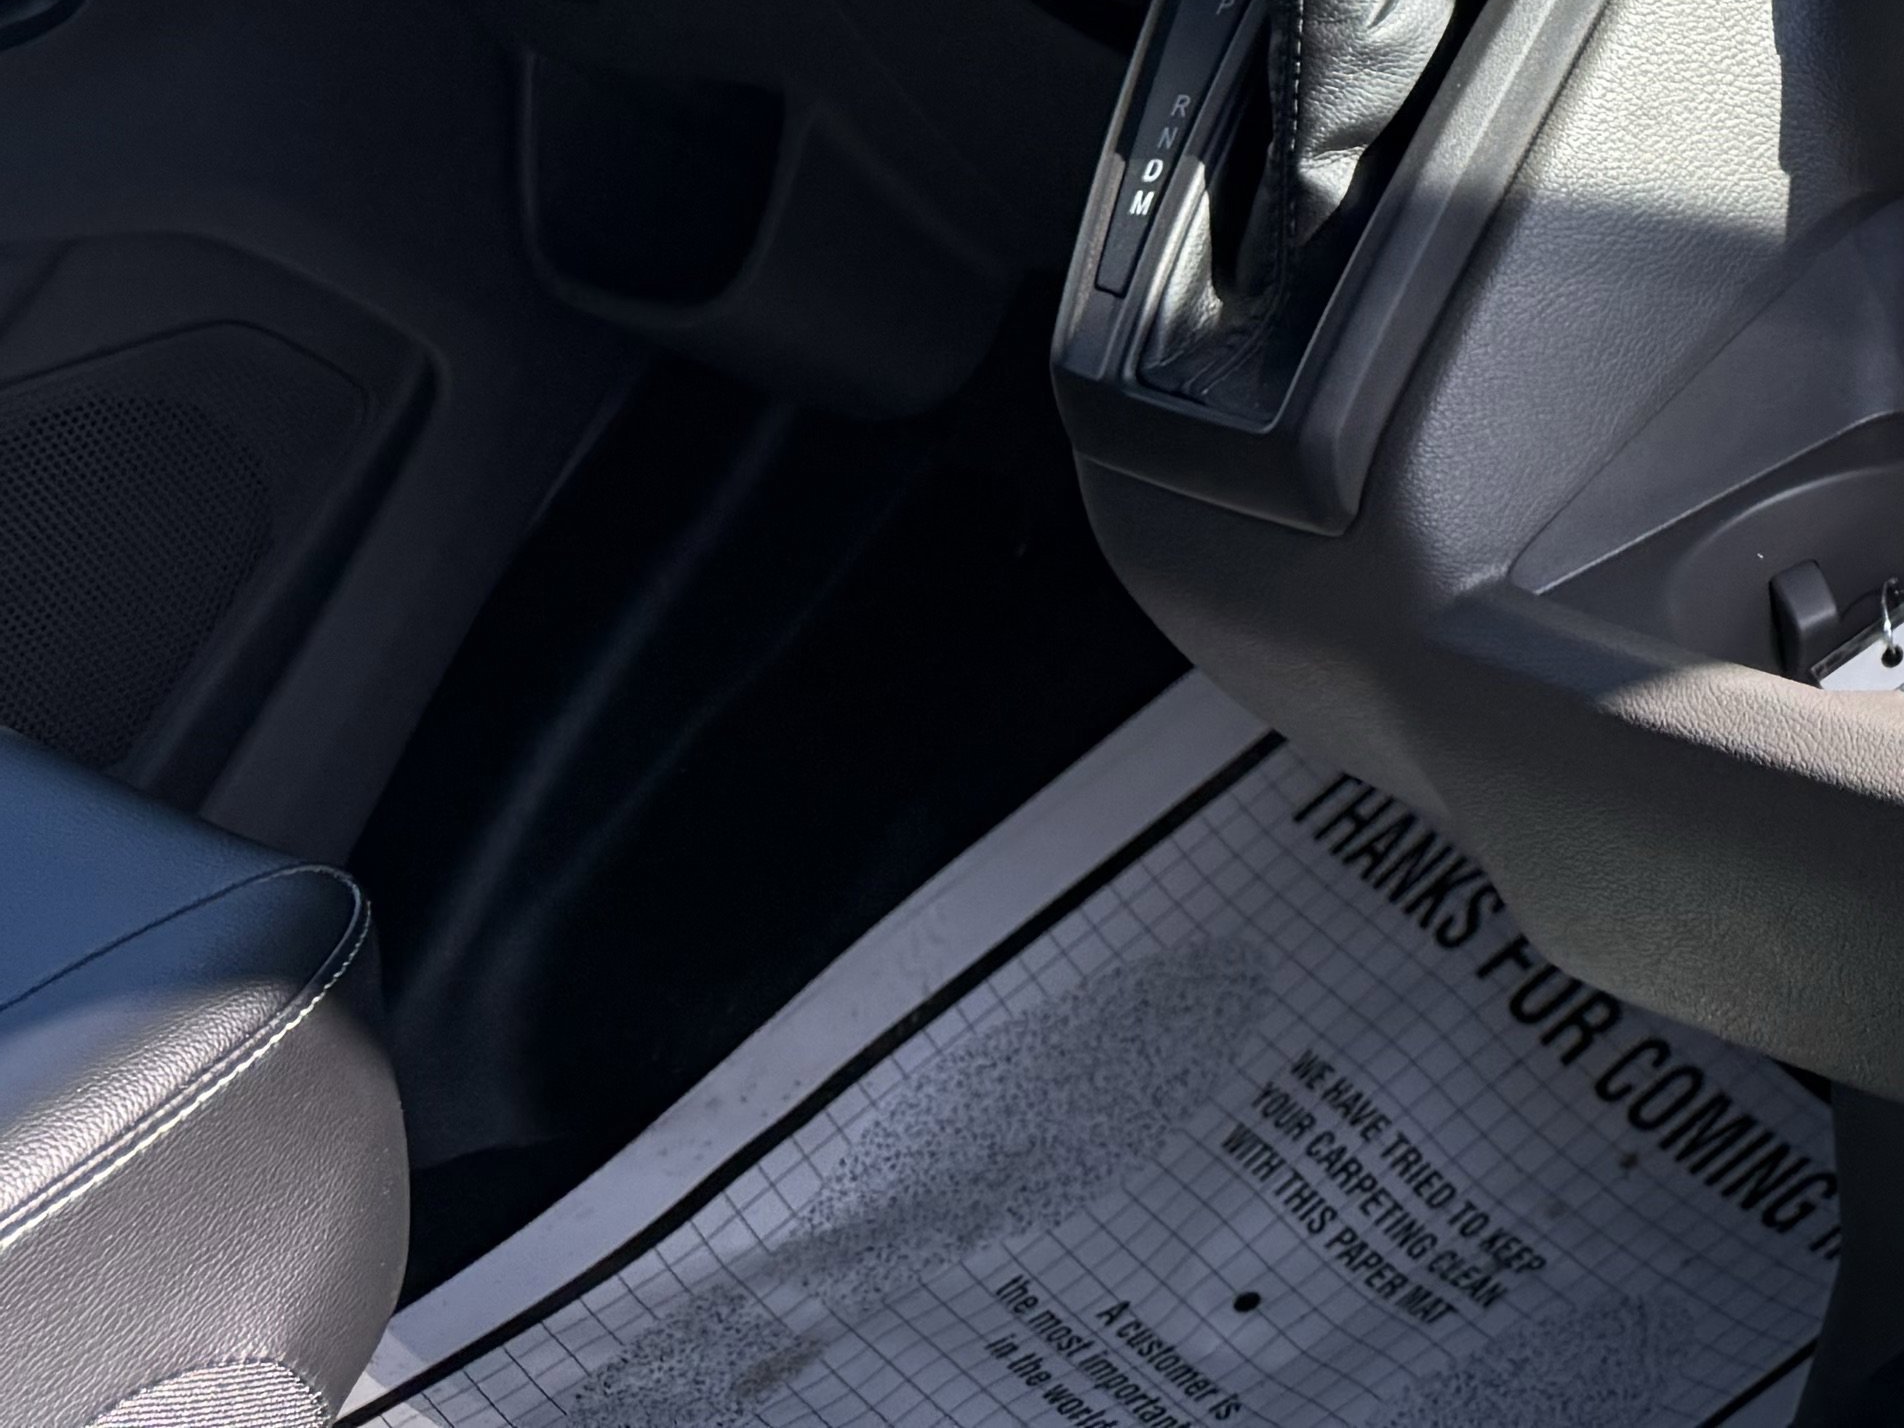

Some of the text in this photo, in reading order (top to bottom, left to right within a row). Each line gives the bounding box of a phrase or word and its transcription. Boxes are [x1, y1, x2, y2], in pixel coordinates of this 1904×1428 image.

[1158, 128, 1178, 149] N
[1171, 95, 1190, 117] R
[1129, 190, 1154, 216] M
[1142, 158, 1163, 182] D
[1291, 771, 1840, 1234] THANKS FOR COMING
[1251, 1081, 1508, 1310] YOUR CARPETING CLEAN
[1291, 1048, 1548, 1276] WE HAVE TRIED TO KEEP
[1220, 1122, 1457, 1325] WITH THIS PAPER MAT
[994, 1274, 1039, 1315] the
[1029, 1310, 1095, 1359] most
[984, 1334, 1020, 1359] in
[1007, 1352, 1052, 1387] the
[1096, 1301, 1245, 1422] A customer is
